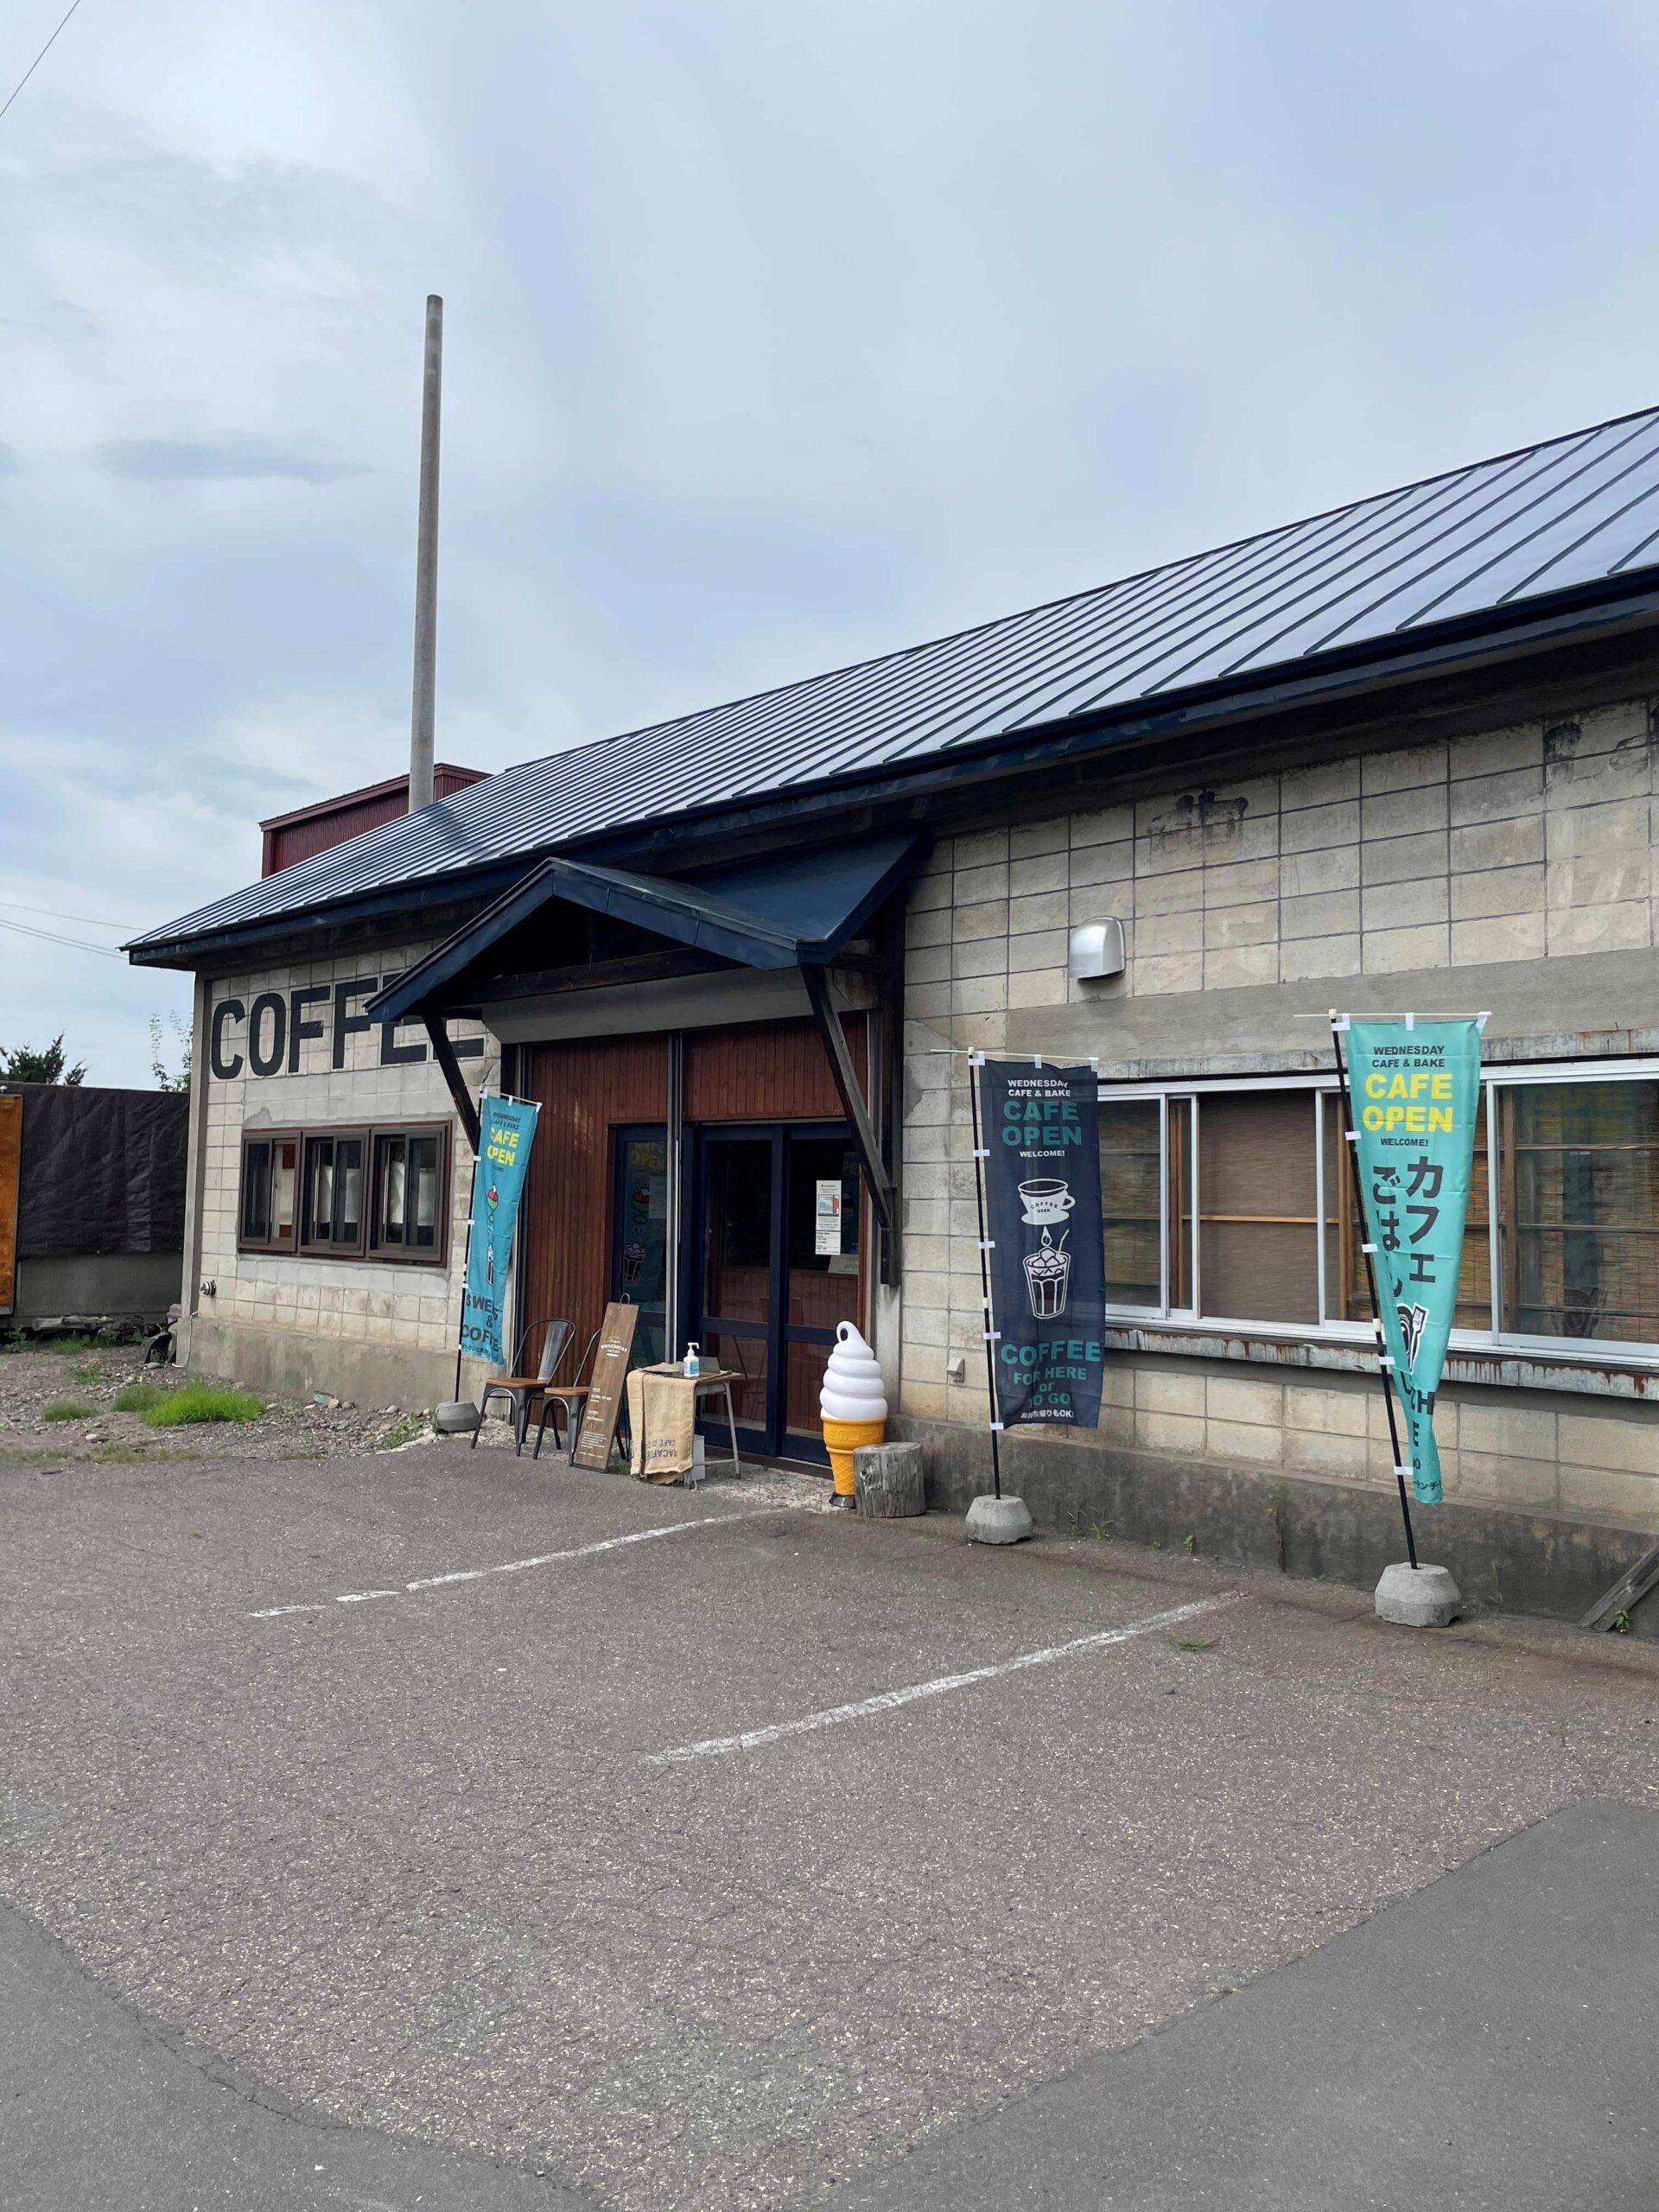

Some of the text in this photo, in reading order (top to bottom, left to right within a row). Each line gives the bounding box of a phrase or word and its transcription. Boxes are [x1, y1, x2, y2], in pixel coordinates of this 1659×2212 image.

[1374, 1046, 1445, 1055] WEDNESDAY
[1372, 1058, 1445, 1068] CAFE & BAKE
[1007, 1079, 1068, 1088] WEDNESDAY
[1365, 1073, 1452, 1099] CAFE
[1003, 1100, 1078, 1121] CAFE
[1363, 1106, 1453, 1133] OPEN
[491, 1127, 519, 1148] CAFE
[1002, 1125, 1082, 1147] OPEN
[1380, 1138, 1428, 1147] WELCOME!
[487, 1145, 516, 1166] OPEN
[1406, 1156, 1444, 1283] カフェ
[1001, 1339, 1101, 1366] COFFEE
[1014, 1366, 1087, 1385] FOR HERE
[1039, 1382, 1054, 1392] or
[1048, 1392, 1071, 1404] GO
